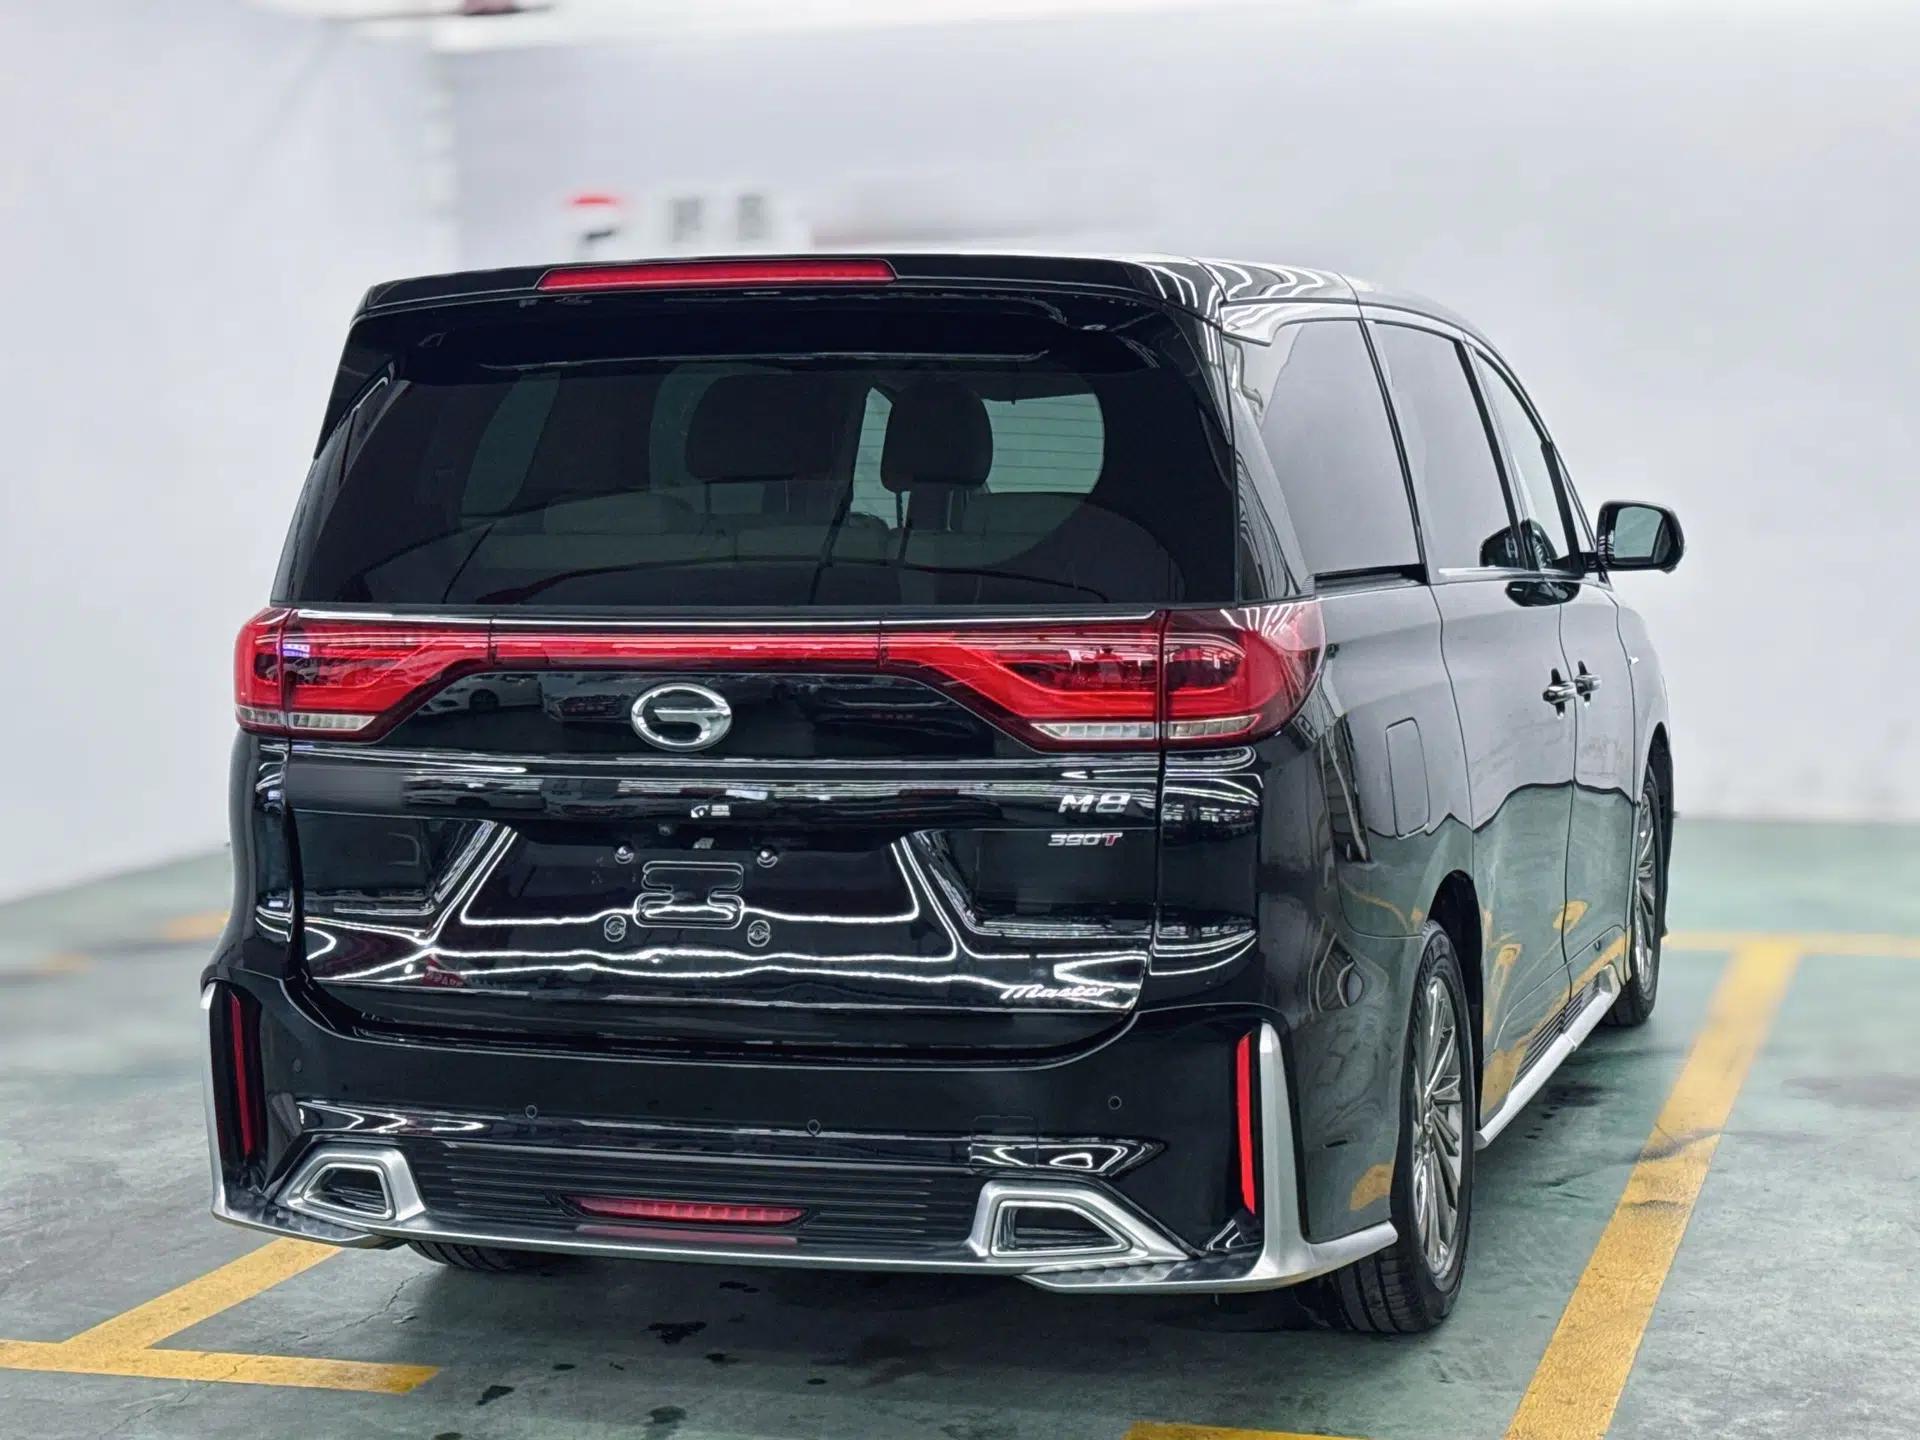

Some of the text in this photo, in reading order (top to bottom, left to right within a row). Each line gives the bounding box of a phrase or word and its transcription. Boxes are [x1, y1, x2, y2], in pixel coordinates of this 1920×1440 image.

[1057, 792, 1132, 814] M8
[1047, 832, 1124, 847] 390T
[1000, 983, 1115, 1000] Master
